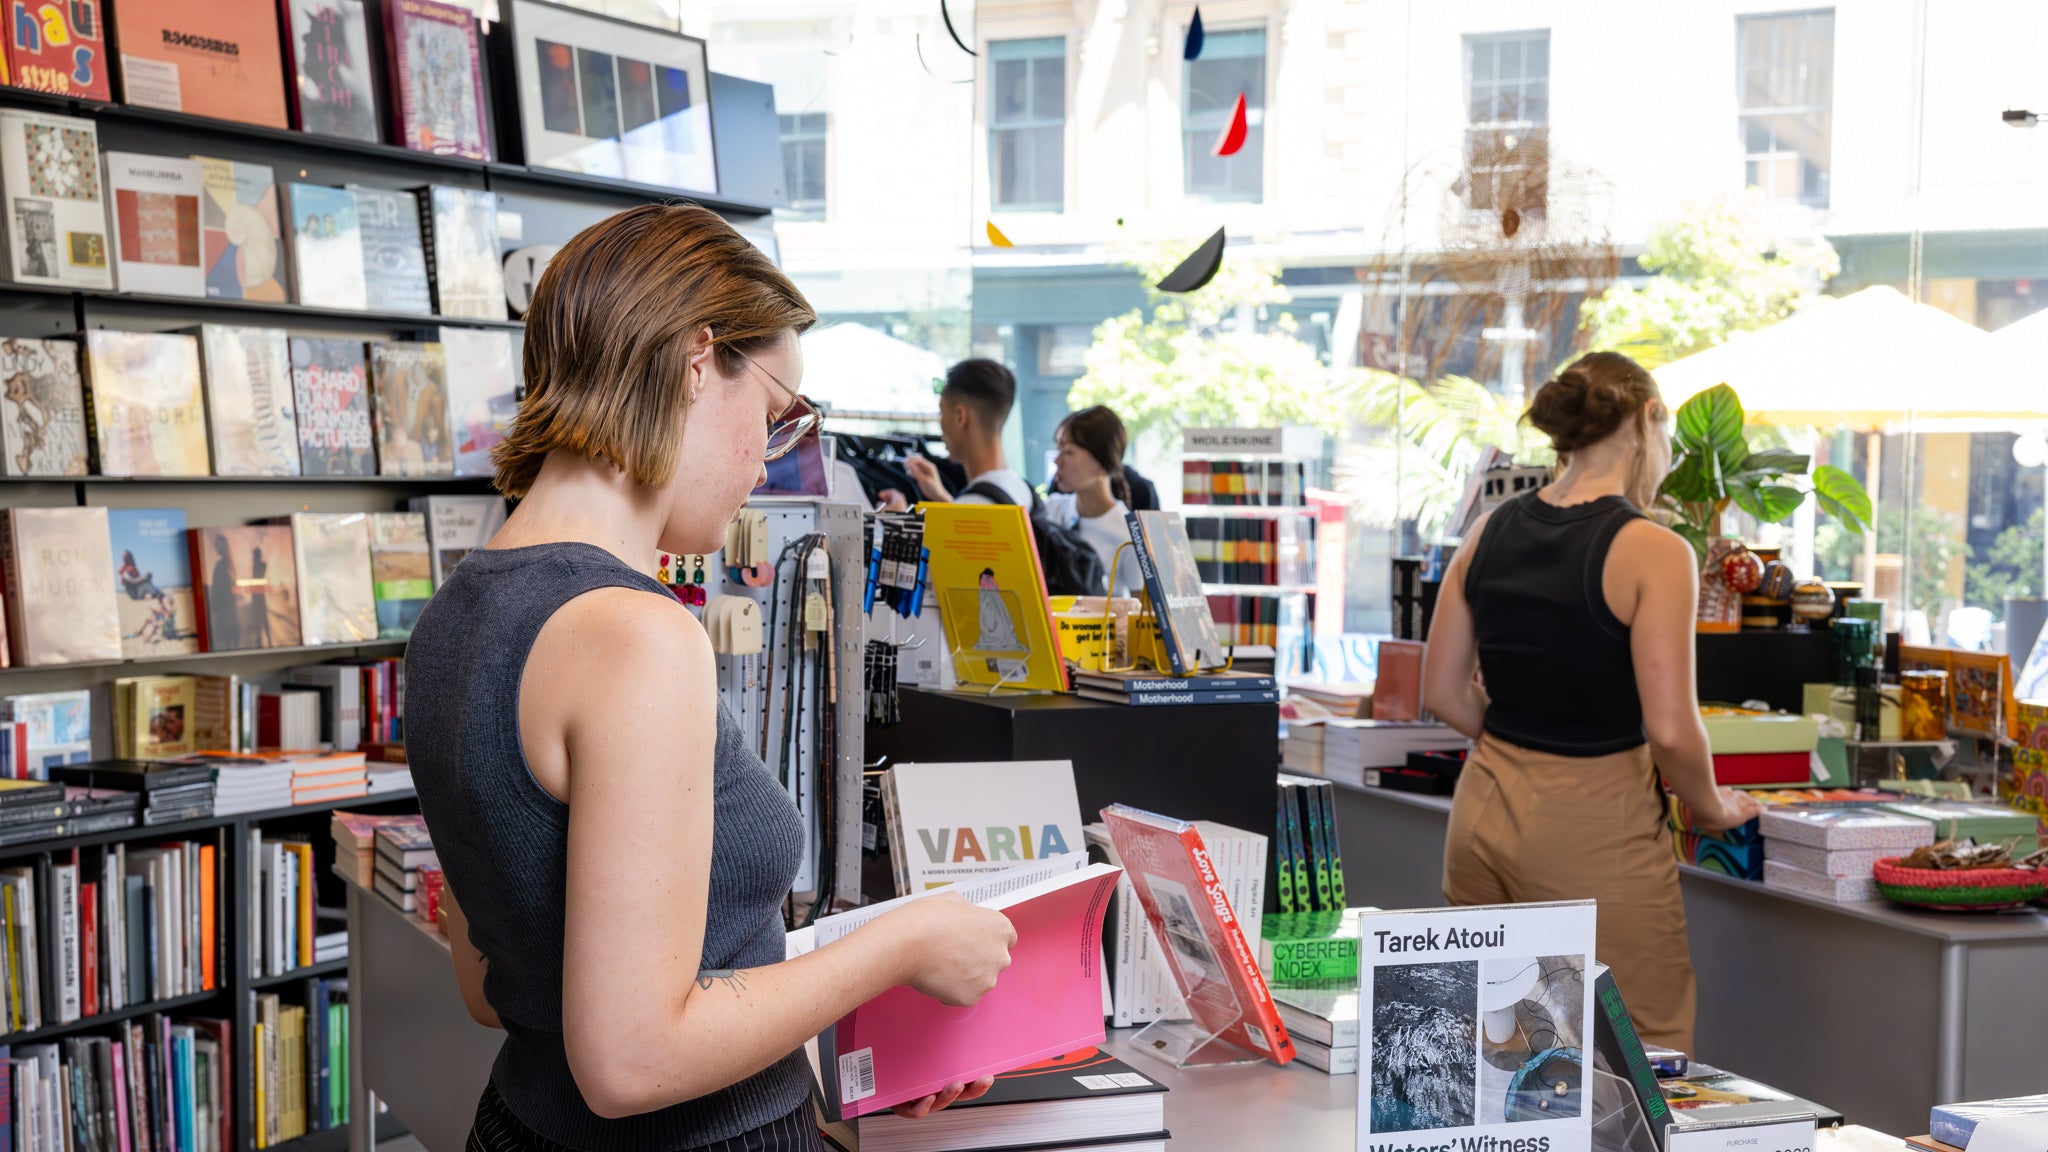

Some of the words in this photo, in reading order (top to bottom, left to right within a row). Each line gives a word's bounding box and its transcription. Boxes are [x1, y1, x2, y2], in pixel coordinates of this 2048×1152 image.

[20, 64, 70, 93] style
[293, 369, 360, 393] RICHARD
[299, 409, 369, 431] THINKING
[300, 428, 371, 449] PICTURES
[1192, 435, 1273, 446] MOLESKINE
[1129, 520, 1154, 580] Motherhood
[1133, 680, 1188, 690] Motherhood
[1139, 693, 1194, 704] Motherhood
[917, 824, 1070, 864] VARIA
[1192, 847, 1216, 885] Love
[1206, 882, 1233, 924] Songs
[1124, 884, 1132, 933] Contemporary
[1122, 934, 1131, 964] Painting
[1374, 928, 1440, 953] Tarek
[1444, 924, 1505, 950] Atoui
[1274, 961, 1321, 979] INDEX
[1726, 1138, 1759, 1147] PURCHASE
